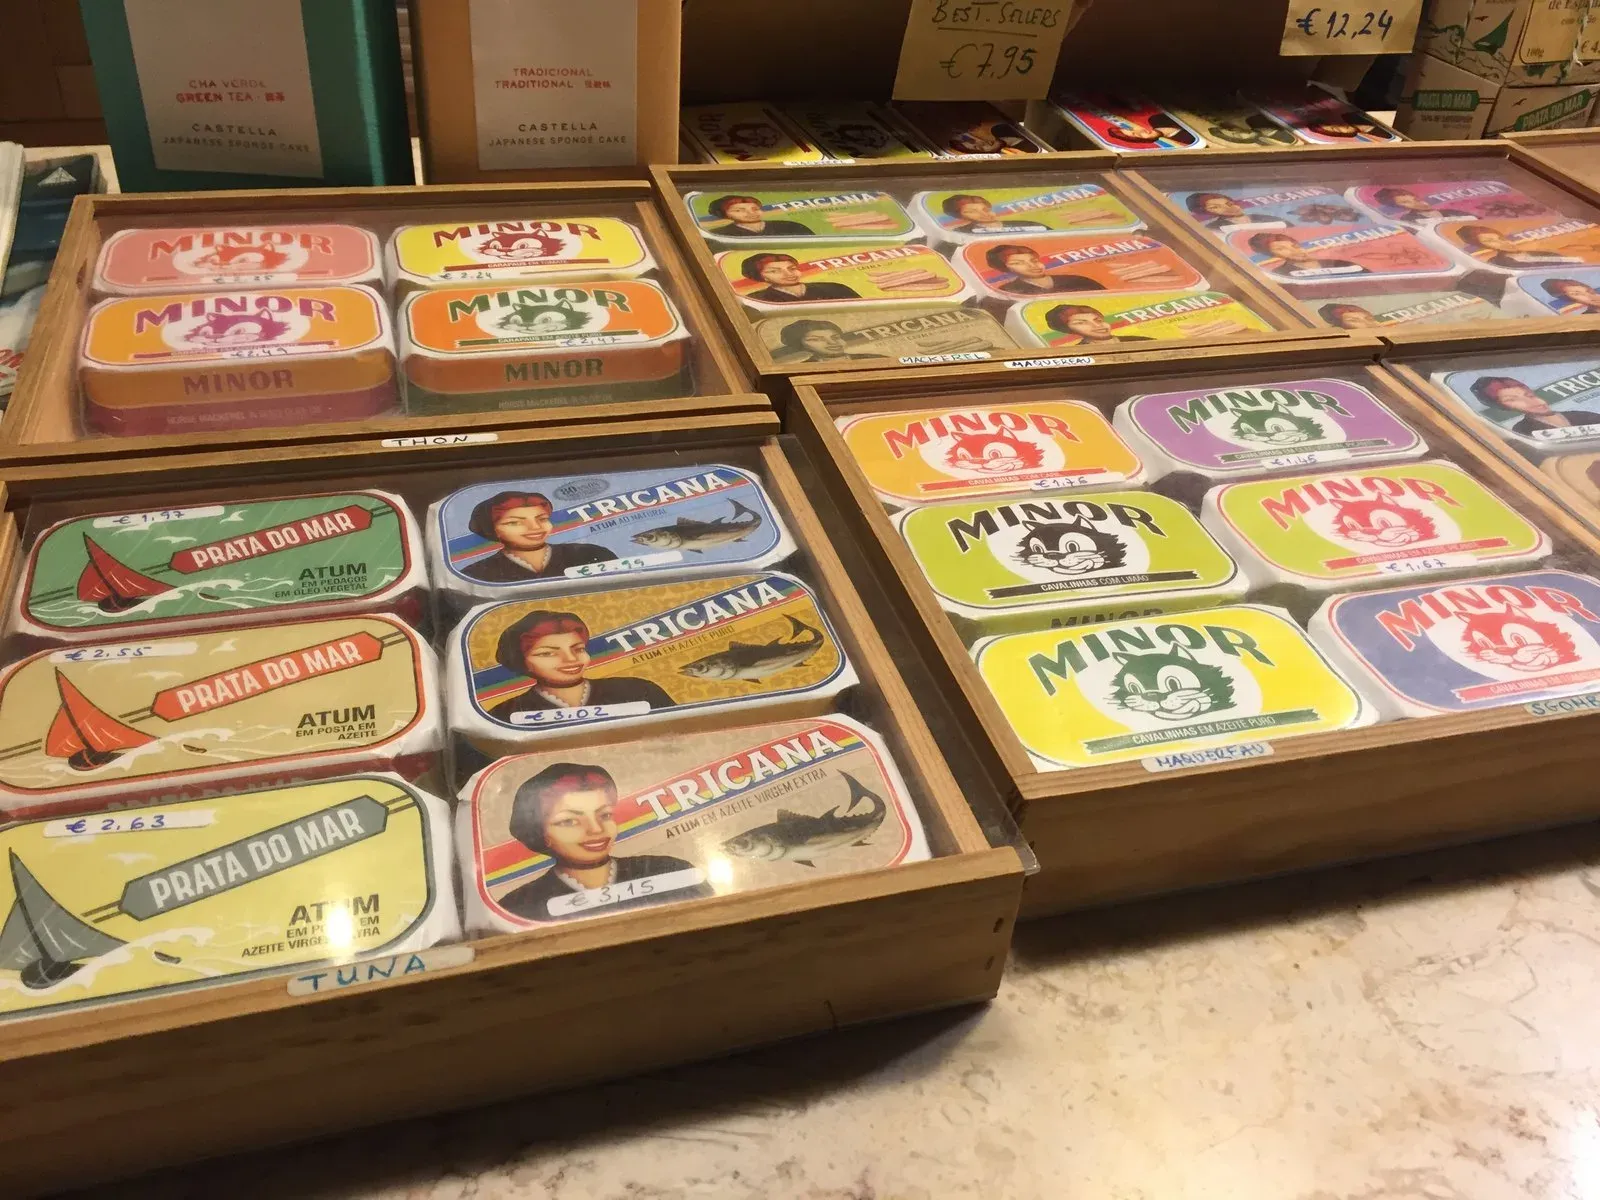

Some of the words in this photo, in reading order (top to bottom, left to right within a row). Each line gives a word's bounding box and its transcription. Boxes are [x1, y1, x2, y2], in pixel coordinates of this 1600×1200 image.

[495, 80, 574, 89] TRADITIONAL
[513, 67, 594, 77] TRADICIONAL
[176, 92, 223, 103] GREEN
[228, 92, 254, 102] TEA
[1563, 94, 1583, 114] MAR
[191, 123, 278, 137] CASTELLA
[518, 122, 598, 132] CASTELLA
[163, 136, 222, 147] JAPANESE
[228, 139, 274, 150] SPONGE
[280, 143, 310, 152] CAKE
[489, 137, 545, 147] JAPANESE
[550, 136, 594, 145] SPONGE
[598, 135, 627, 145] CAKE
[772, 192, 877, 212] TRICANA
[1001, 187, 1098, 213] TRICANA
[1243, 187, 1325, 206] TRICANA
[1428, 182, 1506, 202] TRICANA
[149, 231, 335, 261] MINOR
[432, 219, 602, 249] MINOR
[1309, 225, 1398, 249] TRICANA
[807, 247, 921, 271] TRICANA
[1048, 239, 1153, 264] TRICANA
[135, 295, 337, 335] MINOR
[448, 287, 632, 323] MINOR
[1114, 295, 1222, 324] TRICANA
[1382, 294, 1470, 322] TRICANA
[854, 310, 975, 342] TRICANA
[504, 357, 604, 383] MINOR
[902, 352, 985, 363] MACKEREL
[1011, 357, 1092, 368] MAQUEREAU
[183, 368, 294, 396] MINOR
[1166, 387, 1356, 435] MINOR
[391, 434, 469, 447] THON
[882, 410, 1082, 460] MINOR
[968, 475, 1020, 486] CAVALINHAS
[567, 472, 732, 523] TRICANA
[1259, 475, 1467, 532] MINOR
[589, 519, 617, 533] ATUM
[617, 516, 631, 525] AO
[631, 507, 668, 522] NATURAL
[946, 499, 1169, 555] MINOR
[191, 536, 267, 570] PRATA
[265, 526, 301, 550] DO
[301, 512, 356, 541] MAR
[299, 562, 368, 581] ATUM
[301, 580, 317, 588] EM
[1040, 578, 1099, 592] CAVALINHAS
[1100, 576, 1120, 586] COM
[274, 591, 291, 599] EM
[323, 582, 368, 593] VEGETAL
[604, 579, 789, 654] TRICANA
[1374, 583, 1600, 652] MINOR
[631, 650, 662, 666] ATUM
[663, 645, 677, 656] EM
[677, 635, 708, 653] AZEITE
[708, 625, 735, 643] PURO
[1027, 622, 1277, 698] MINOR
[176, 672, 259, 714] PRATA
[263, 657, 302, 686] DO
[304, 640, 364, 674] MAR
[297, 704, 376, 729] ATUM
[295, 729, 314, 738] EM
[316, 725, 355, 736] POSTA
[357, 722, 376, 732] EM
[337, 729, 378, 741] AZEITE
[1132, 726, 1198, 745] CAVALINHAS
[1199, 724, 1214, 735] EM
[1215, 720, 1249, 733] AZEITE
[1249, 716, 1276, 729] PURO
[635, 729, 843, 824] TRICANA
[666, 819, 700, 839] ATUM
[701, 812, 718, 825] EM
[718, 800, 753, 818] AZEITE
[753, 781, 794, 804] VIRGEM
[794, 767, 828, 790] EXTRA
[149, 848, 246, 909] PRATA
[250, 832, 293, 873] DO
[297, 807, 365, 859] MAR
[286, 927, 308, 939] EM
[359, 915, 380, 927] EM
[241, 941, 285, 958] AZEITE
[300, 953, 428, 992] TUNA
